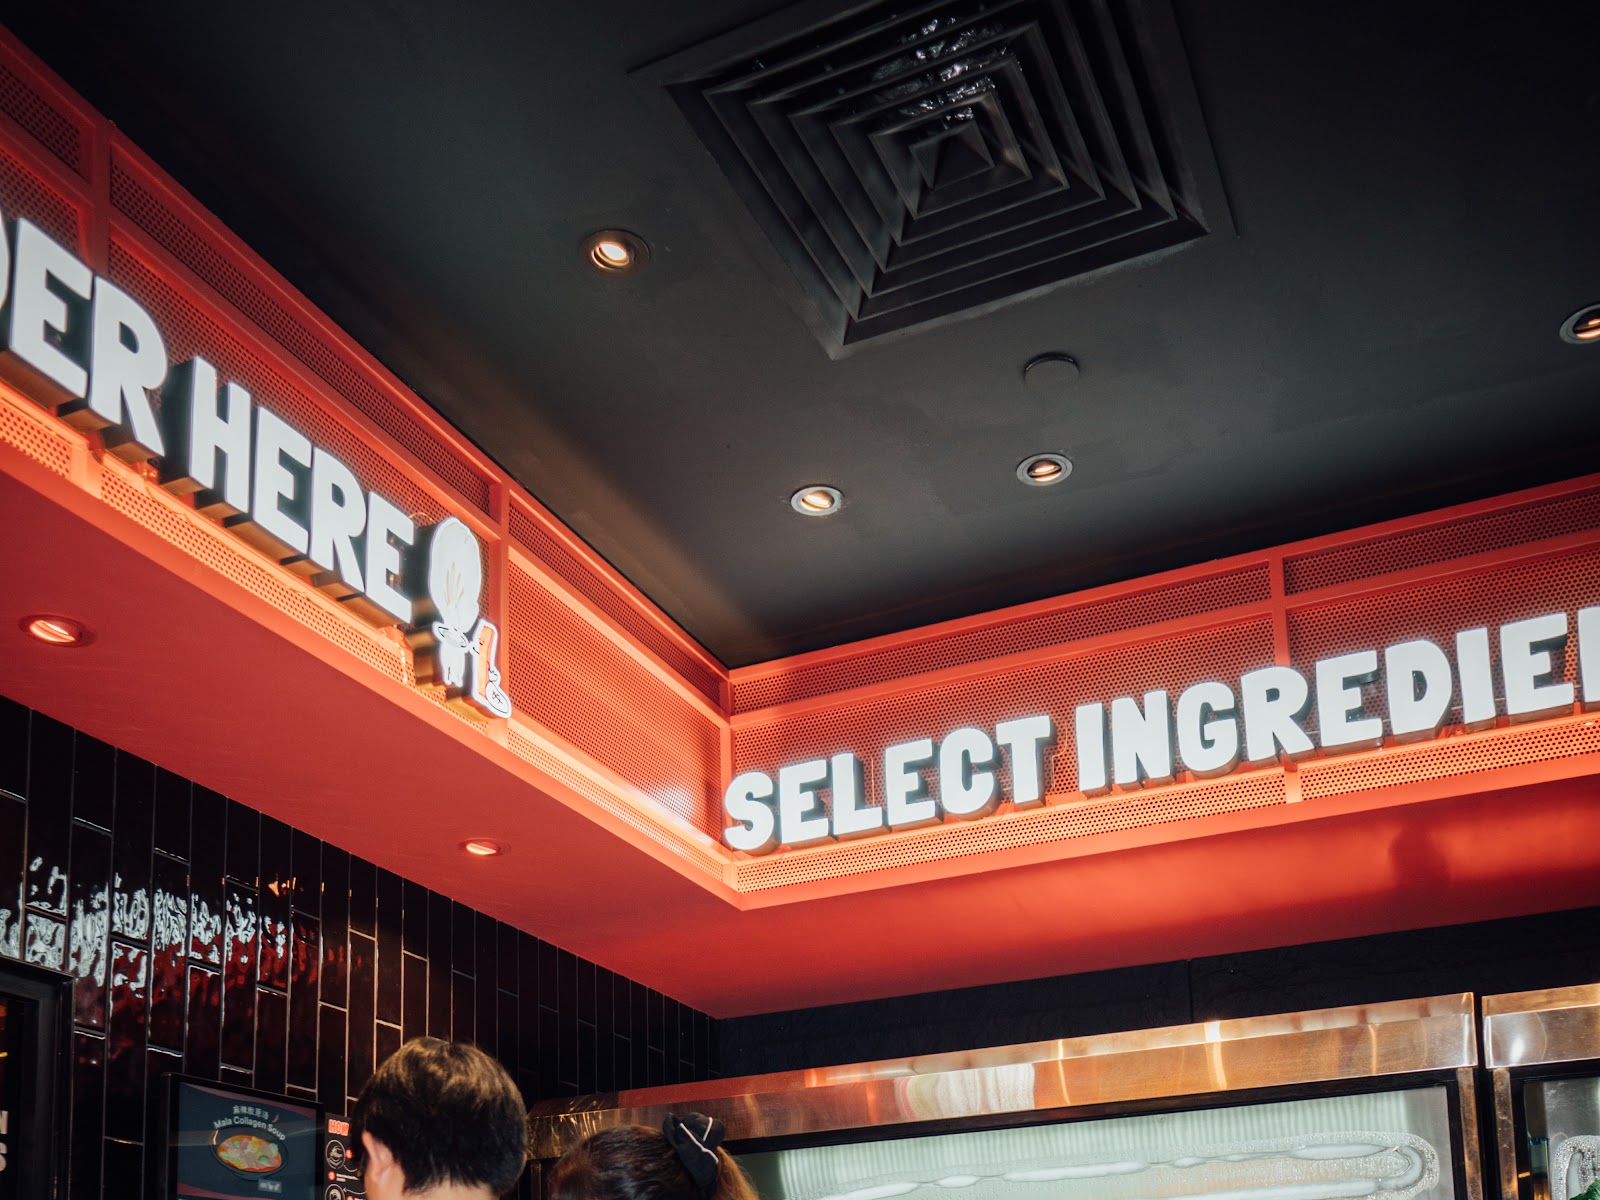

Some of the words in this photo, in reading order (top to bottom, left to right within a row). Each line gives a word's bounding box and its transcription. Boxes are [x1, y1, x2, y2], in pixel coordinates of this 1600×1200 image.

[0, 207, 167, 457] ER
[189, 355, 415, 624] HERE
[724, 715, 1051, 850] SELECT
[214, 1117, 232, 1129] Mala
[234, 1116, 266, 1128] Collagen
[268, 1123, 286, 1140] Soup
[328, 1119, 349, 1136] HOW
